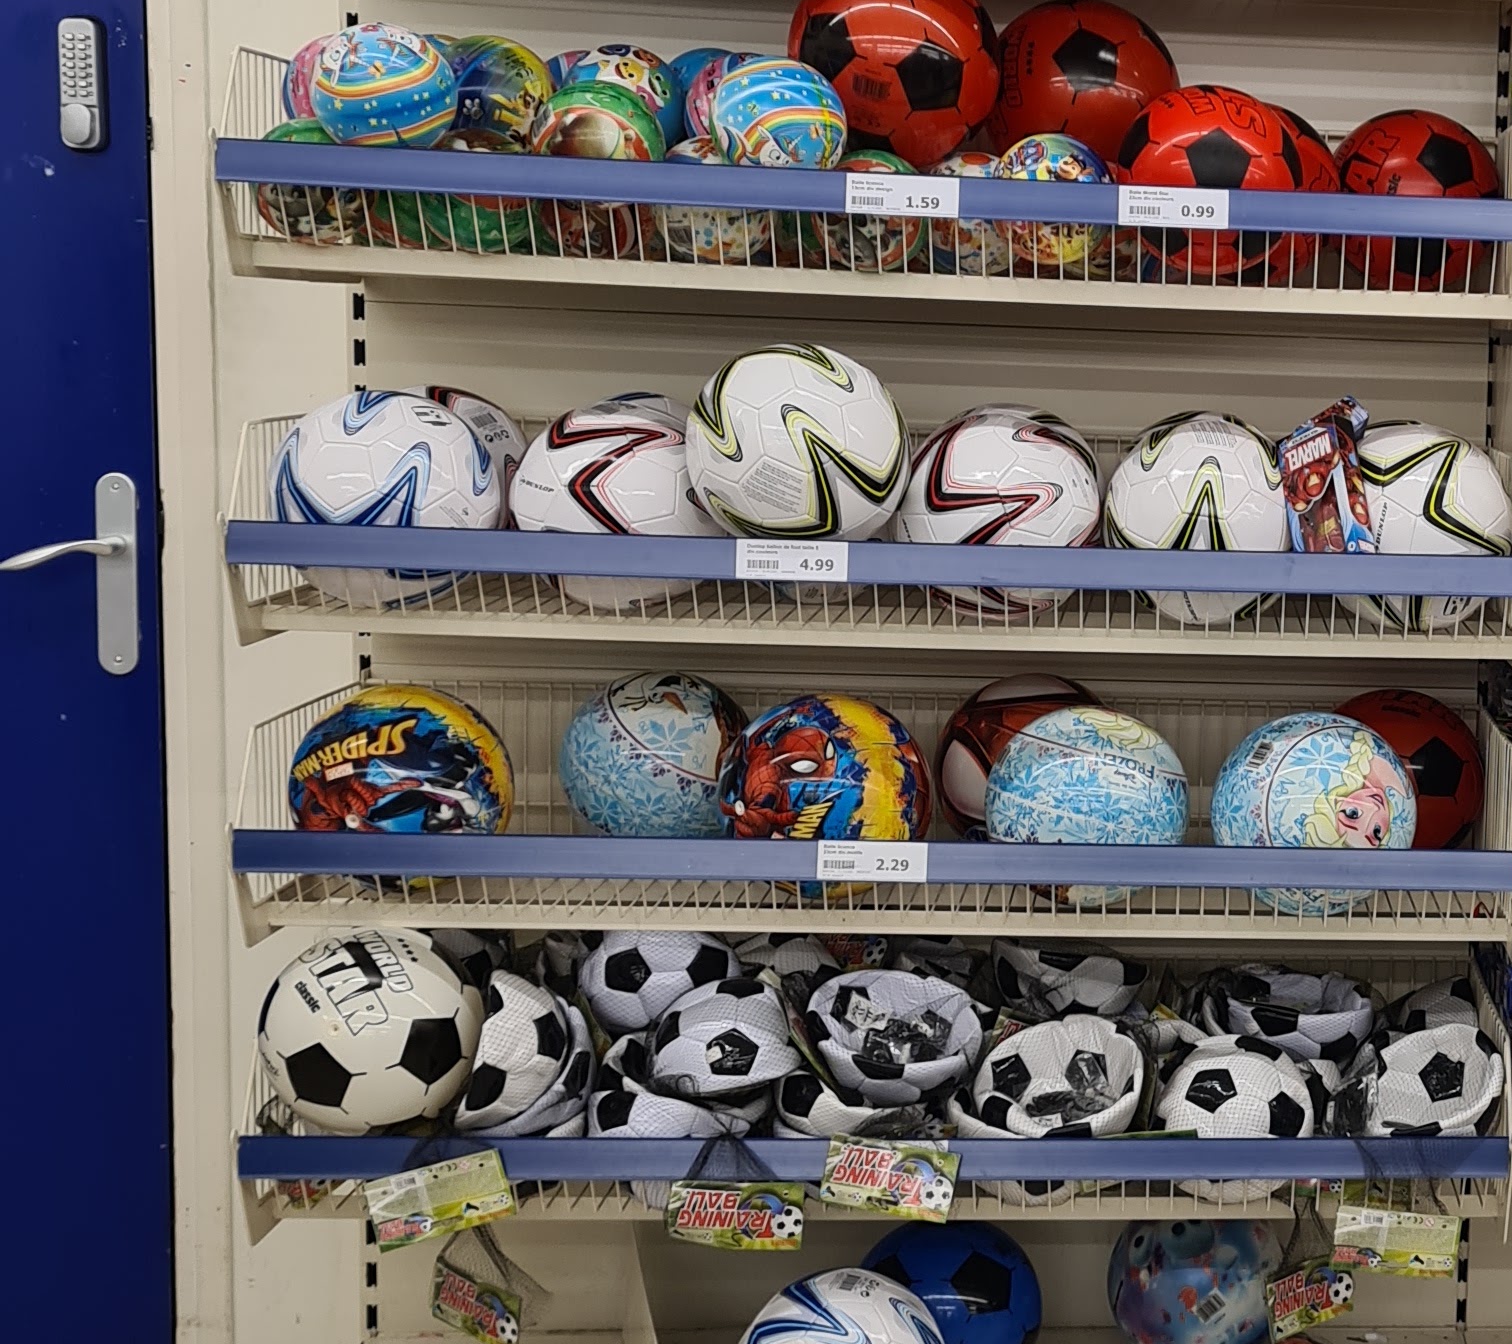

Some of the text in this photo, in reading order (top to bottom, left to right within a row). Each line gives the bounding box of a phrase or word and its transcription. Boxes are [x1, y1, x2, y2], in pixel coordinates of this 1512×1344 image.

[906, 196, 940, 209] 1.59
[1181, 205, 1215, 218] 0.99
[1284, 433, 1333, 472] MARVEL
[523, 480, 555, 495] DUNLOP
[1375, 501, 1388, 545] DUNLOP
[799, 558, 834, 571] 4.99
[875, 858, 909, 871] 2.29
[353, 929, 414, 993] WORLD
[294, 981, 321, 1014] classic
[298, 937, 389, 1036] STAR
[842, 1147, 898, 1168] BALL
[684, 1189, 743, 1210] BALL
[832, 1165, 923, 1207] TRAINING
[677, 1210, 776, 1239] TRAINING
[1273, 1270, 1305, 1301] BALL
[1273, 1281, 1334, 1322] TRAINING
